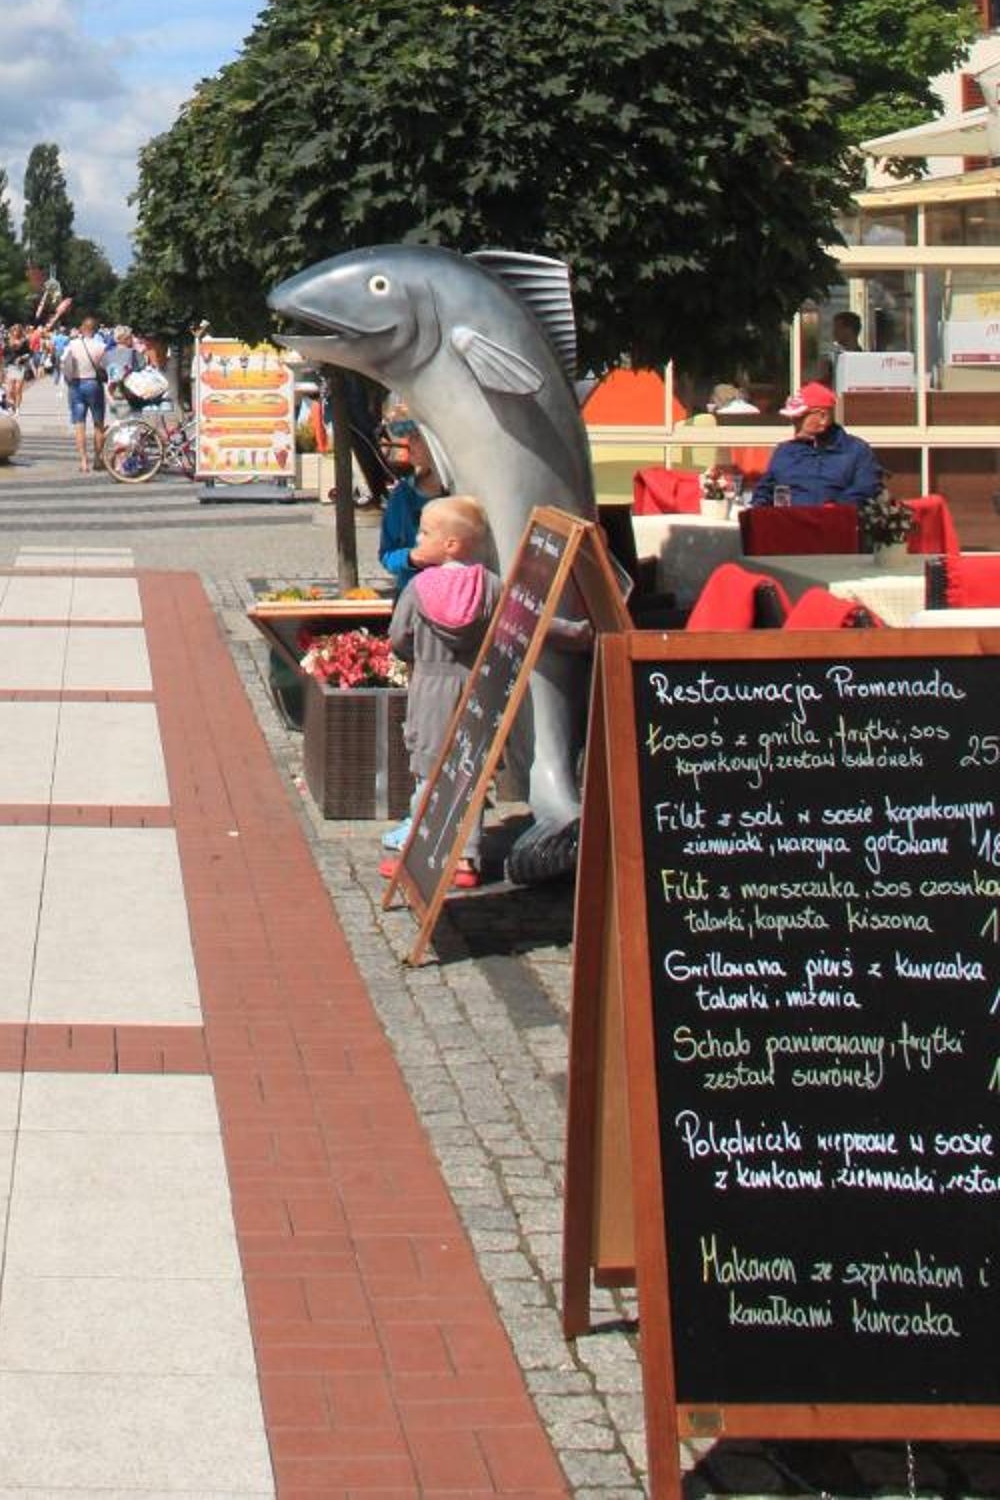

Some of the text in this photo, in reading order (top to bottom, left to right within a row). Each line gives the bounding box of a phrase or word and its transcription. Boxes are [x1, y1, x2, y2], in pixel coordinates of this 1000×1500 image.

[649, 665, 967, 725] Restauracja Promenada
[735, 733, 748, 747] z
[909, 724, 950, 740] sos
[960, 735, 1000, 767] 25
[655, 801, 707, 833] Filet
[717, 813, 732, 827] z
[739, 800, 784, 827] soli
[821, 799, 873, 825] sosie
[885, 795, 995, 847] koperkowym
[661, 869, 709, 903] Filet
[719, 885, 732, 899] z
[871, 881, 913, 897] sos
[919, 868, 1000, 897] czosnko
[754, 903, 830, 941] kapusta
[867, 963, 883, 978] z
[673, 1025, 751, 1062] Schab
[934, 1123, 994, 1155] sosie
[714, 1171, 729, 1189] z
[946, 1164, 1000, 1193] zesta
[700, 1234, 797, 1284] Makaron
[842, 1250, 964, 1300] szpinakiem
[980, 1257, 990, 1287] i
[853, 1298, 961, 1337] kurczaka
